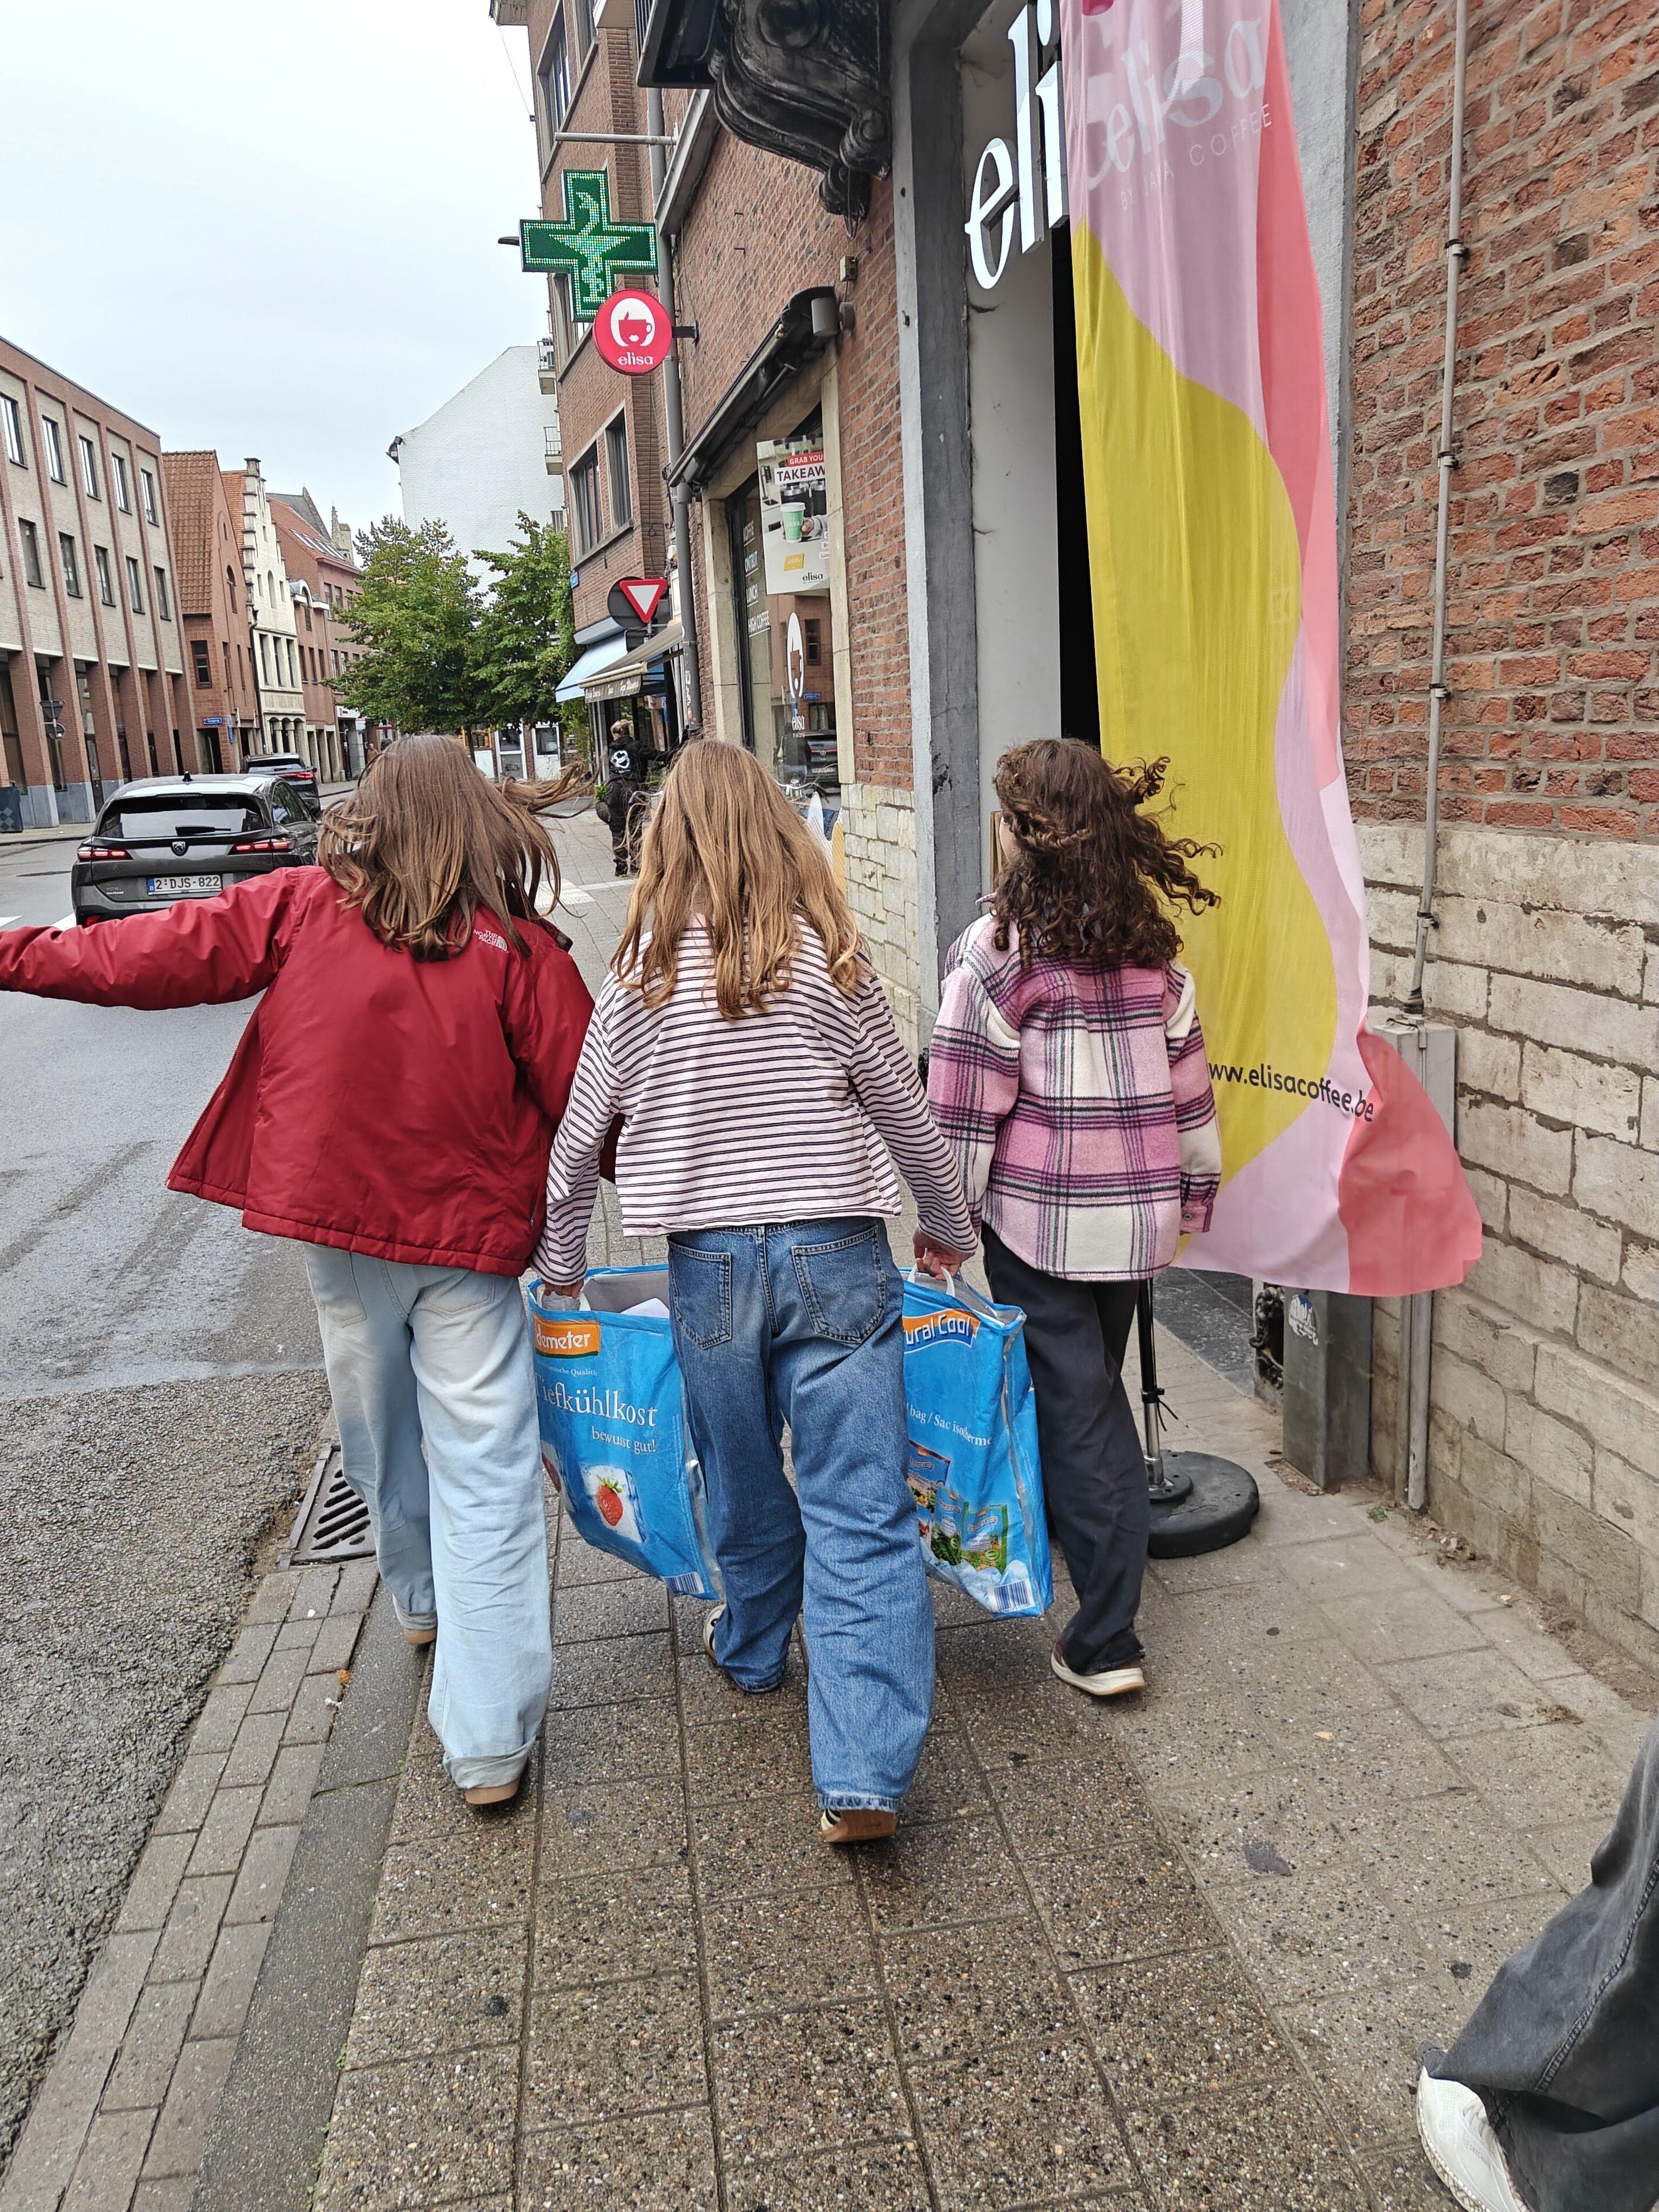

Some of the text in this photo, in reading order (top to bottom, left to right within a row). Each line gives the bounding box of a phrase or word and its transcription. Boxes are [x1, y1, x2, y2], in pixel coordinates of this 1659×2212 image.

[1103, 18, 1265, 173] elisa
[965, 0, 1069, 289] eli
[1189, 103, 1272, 166] COFFEE
[617, 352, 654, 366] elisa
[790, 456, 808, 465] GRAB
[777, 465, 825, 482] TAKEAW
[802, 572, 824, 582] elisa
[473, 929, 497, 944] NORTH
[478, 935, 496, 946] FACE
[484, 929, 498, 938] THE
[1208, 1061, 1374, 1123] ww.elisacoffee.be
[536, 1324, 591, 1350] demeter
[904, 1314, 972, 1345] ural Cool
[535, 1372, 657, 1427] Tiefkühlkost
[909, 1405, 926, 1424] bag
[934, 1414, 951, 1430] Sac
[591, 1426, 656, 1454] bewusst gut!
